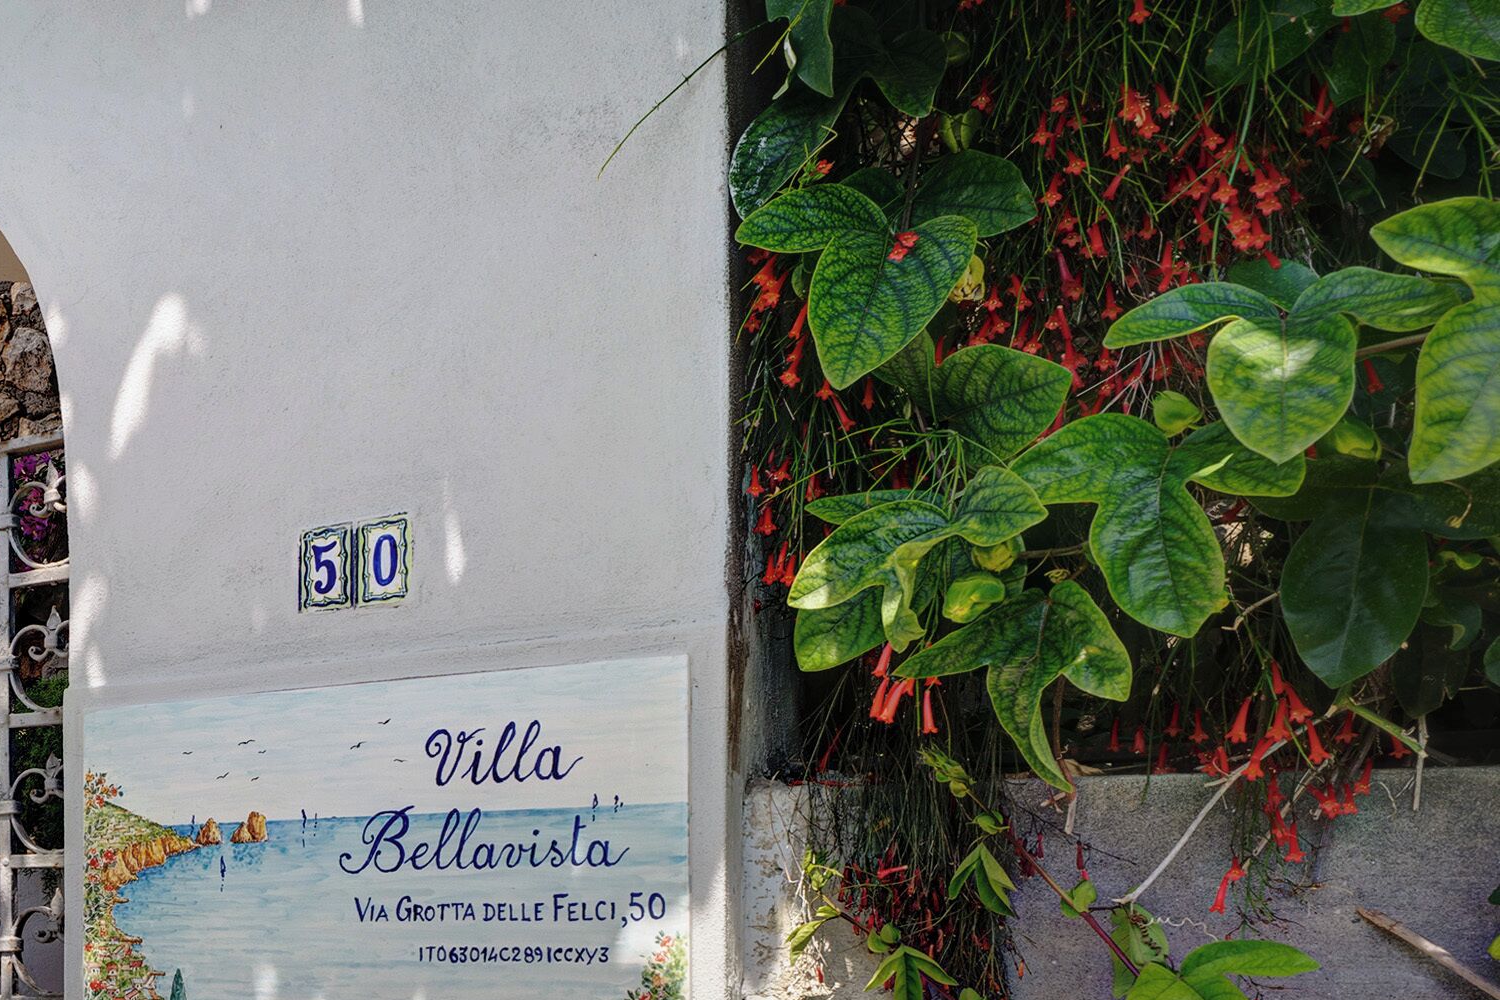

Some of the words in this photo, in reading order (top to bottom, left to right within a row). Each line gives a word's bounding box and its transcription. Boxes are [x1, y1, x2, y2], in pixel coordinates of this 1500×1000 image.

[311, 534, 398, 594] 50
[425, 719, 583, 787] Villa
[339, 805, 630, 874] Bellavista
[354, 897, 389, 922] VIA
[395, 895, 476, 922] GROTTA
[482, 902, 544, 922] DELLE
